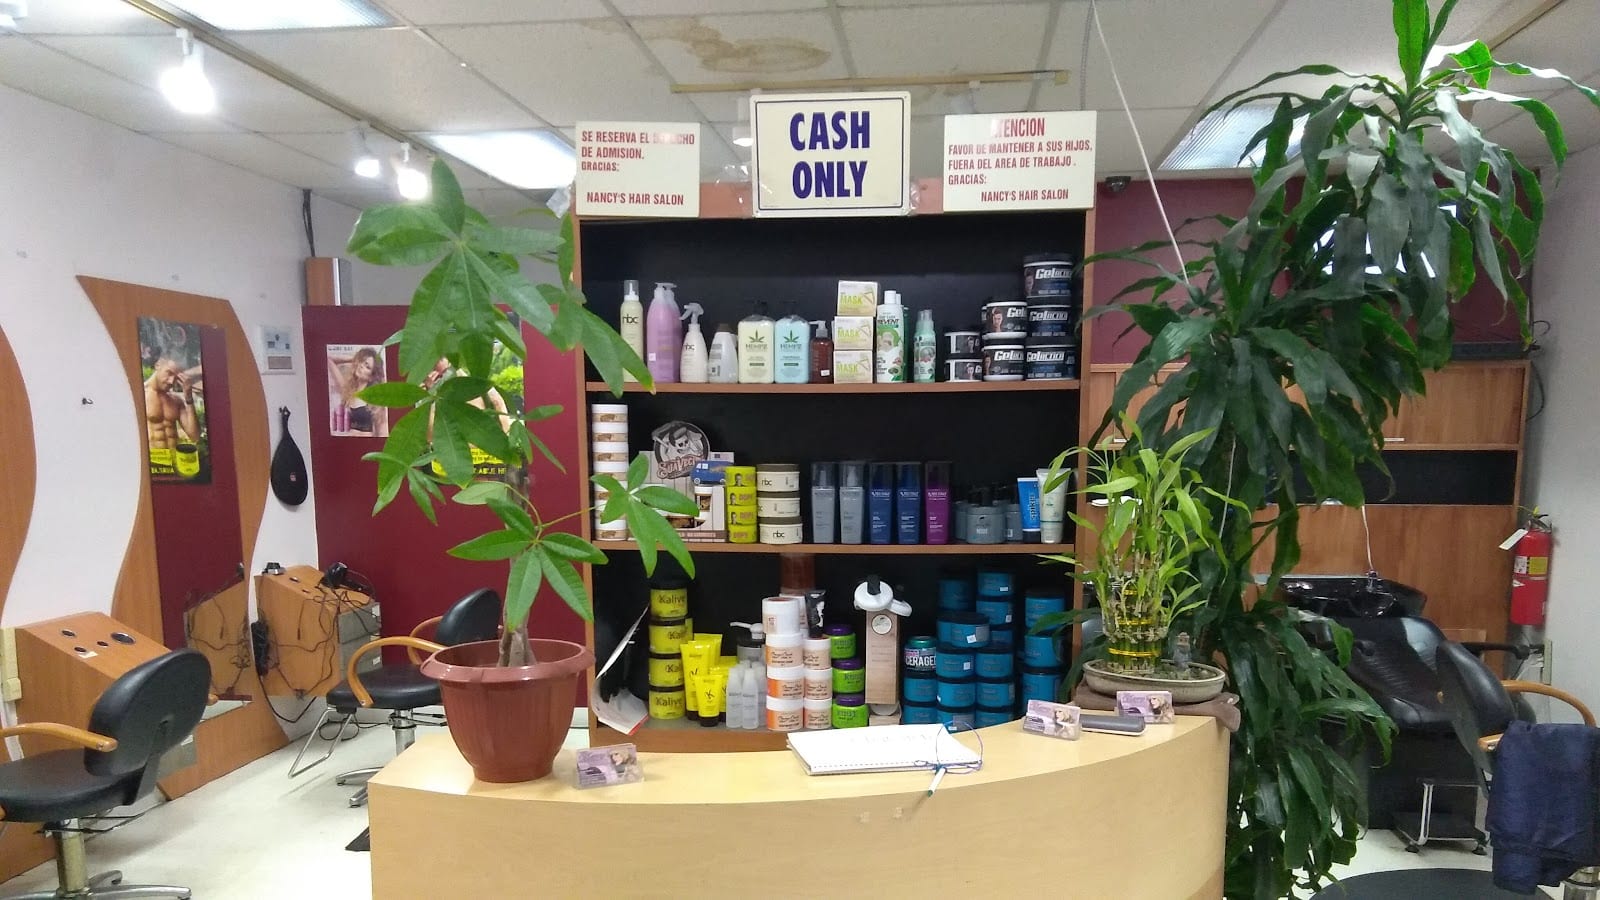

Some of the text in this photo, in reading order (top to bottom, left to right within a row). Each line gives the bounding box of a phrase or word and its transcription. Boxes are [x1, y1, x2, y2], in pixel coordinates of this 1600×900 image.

[790, 110, 870, 151] CASH
[992, 118, 1045, 138] TENCION
[581, 130, 695, 145] SE RESERVA EL DCHO
[581, 146, 645, 160] DE ADMISION.
[948, 144, 975, 155] FAVOR
[976, 143, 987, 155] DE
[989, 142, 1035, 154] MANTENER
[1037, 141, 1043, 152] A
[1046, 140, 1063, 152] SUS
[948, 159, 975, 171] FUERA
[977, 158, 992, 169] DEL
[995, 157, 1017, 169] AREA
[1020, 156, 1030, 168] DE
[792, 160, 868, 199] ONLY
[948, 174, 987, 185] GRACIAS:
[586, 191, 684, 206] NANCY'S HAIR SALON
[981, 188, 1069, 202] NANCY'S HAIR SALON
